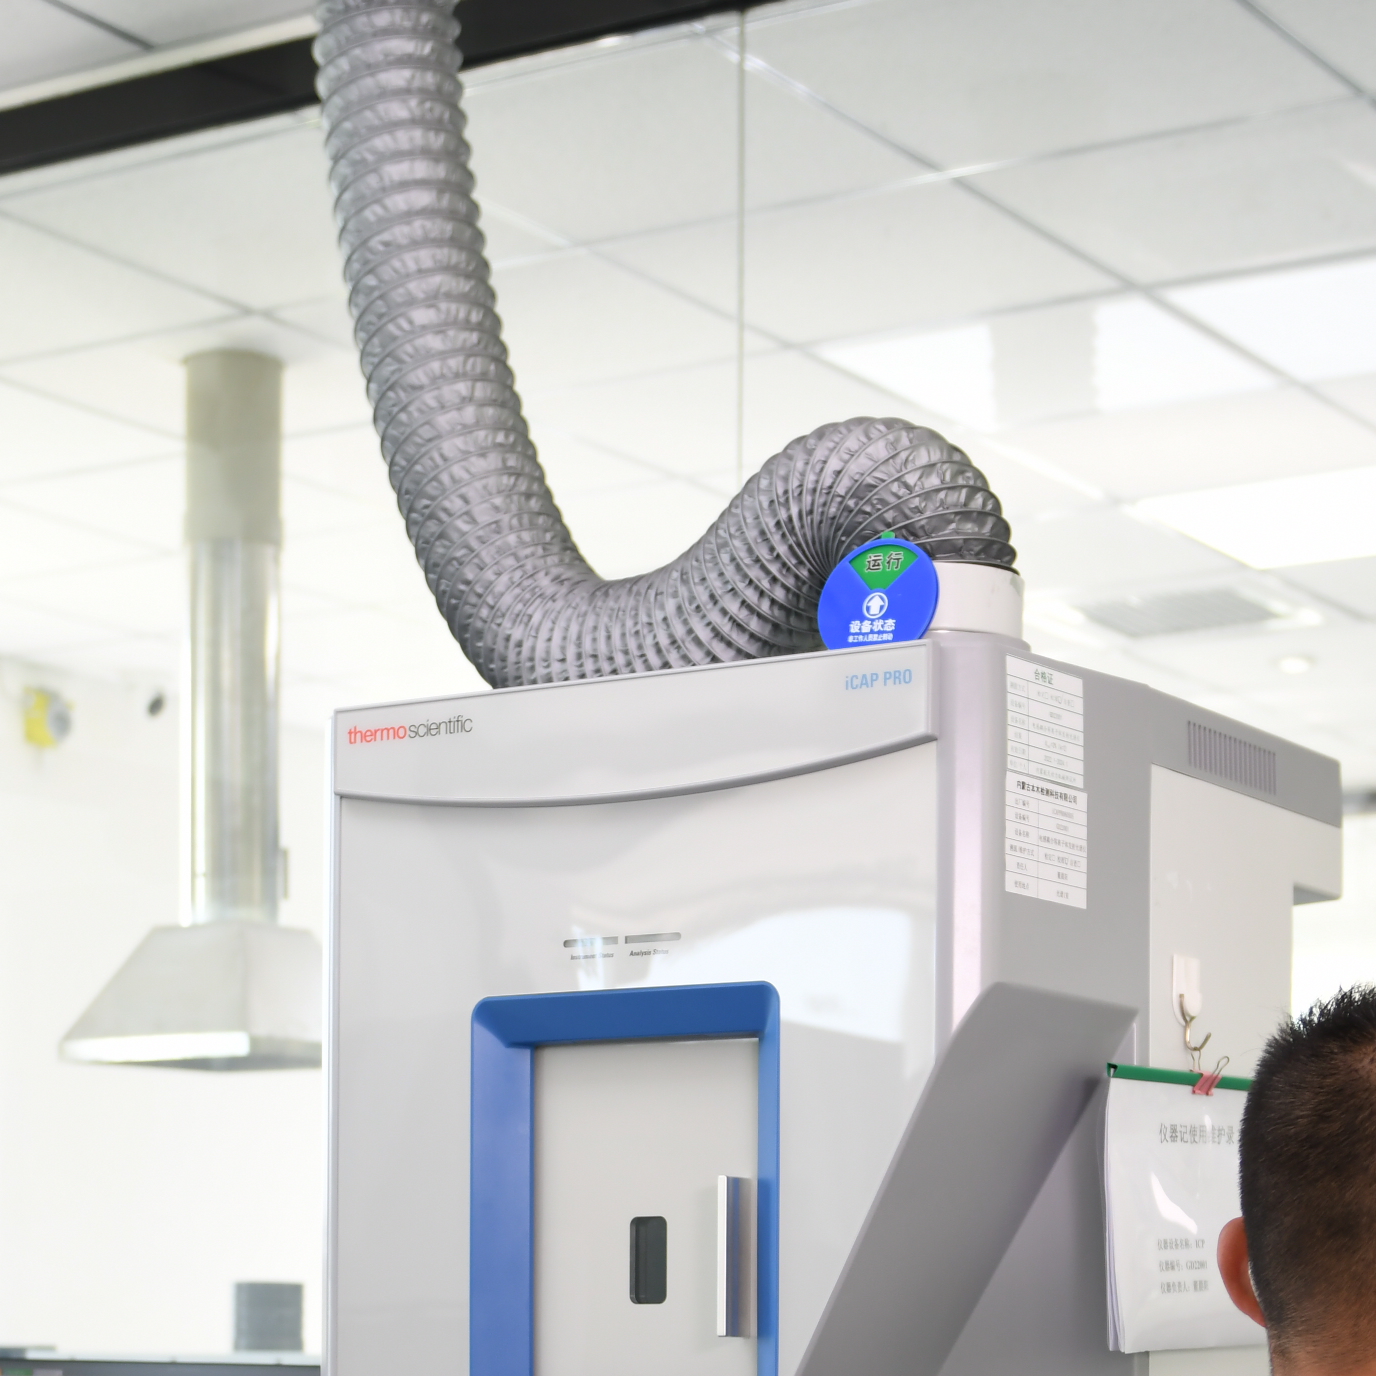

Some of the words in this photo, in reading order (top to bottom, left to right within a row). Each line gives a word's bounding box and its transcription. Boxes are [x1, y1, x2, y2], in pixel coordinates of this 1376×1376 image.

[865, 551, 904, 572] 运行
[849, 619, 896, 633] 设备状态
[844, 672, 879, 691] iCAP
[883, 668, 912, 687] PRO
[1034, 668, 1054, 685] 合格证
[629, 948, 651, 957] Analysis
